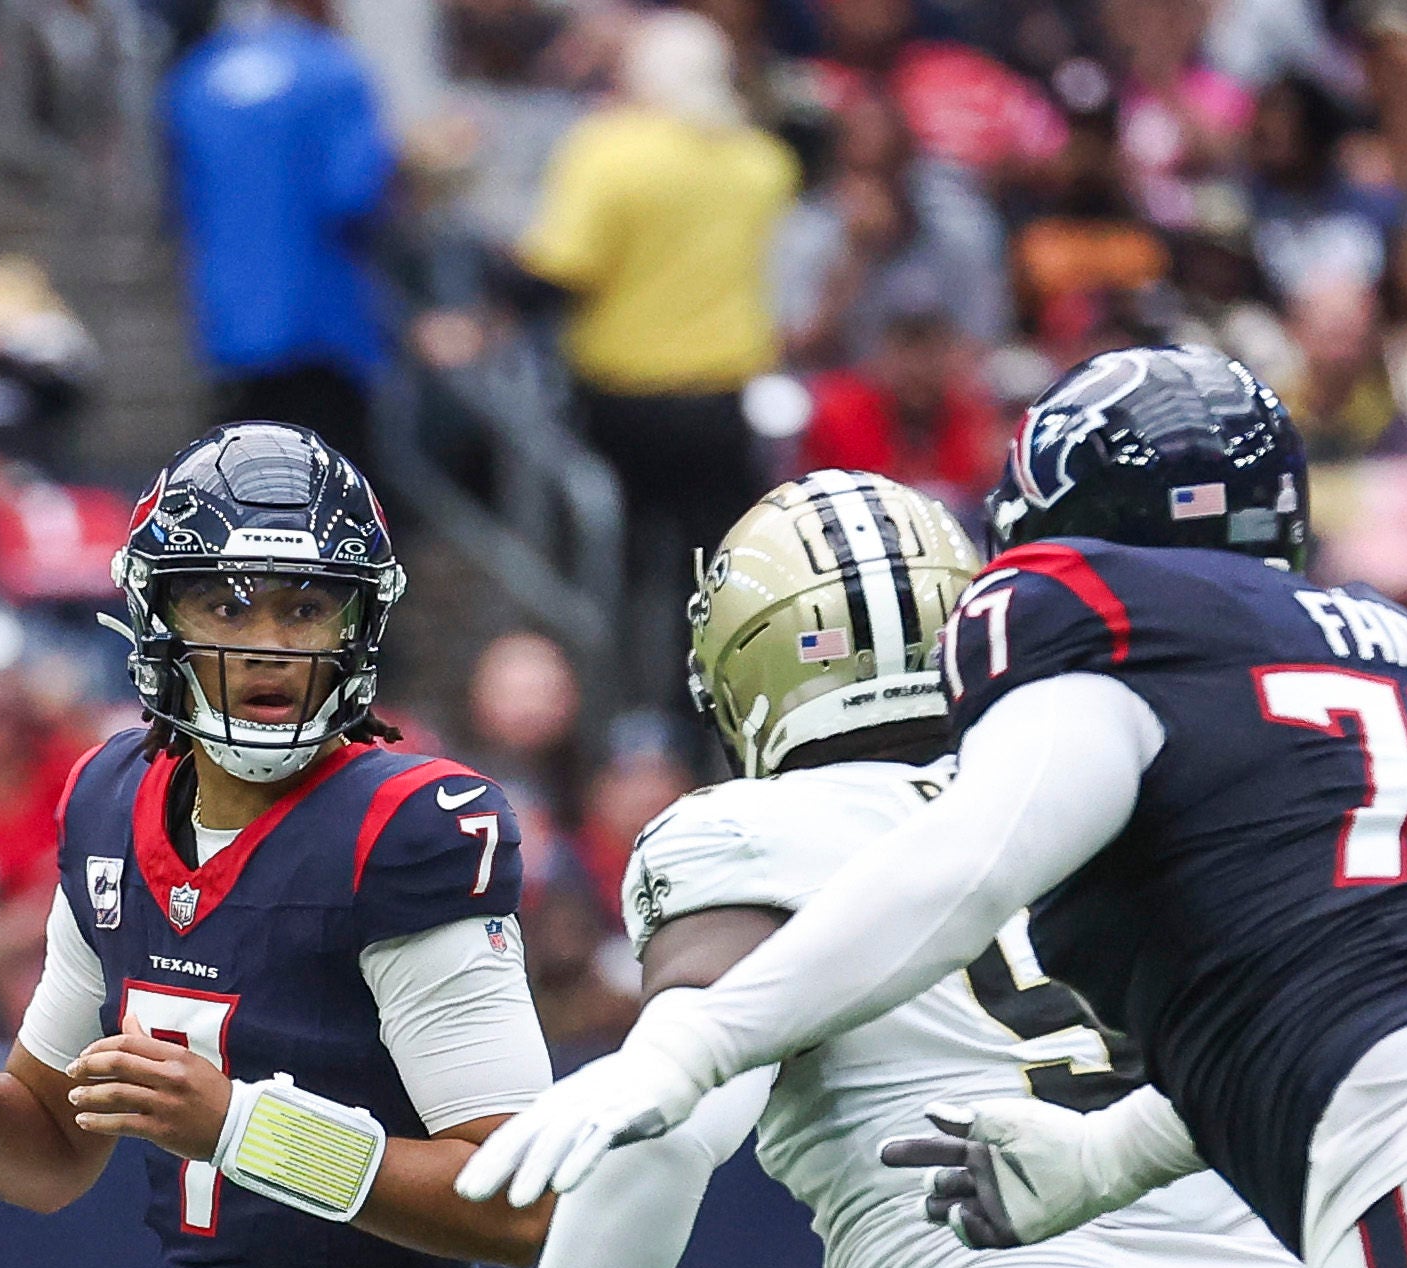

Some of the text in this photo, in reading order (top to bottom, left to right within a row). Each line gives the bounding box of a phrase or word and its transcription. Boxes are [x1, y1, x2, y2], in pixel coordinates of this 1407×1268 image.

[163, 544, 200, 552] OAKLEY
[242, 533, 304, 544] TEXANS
[456, 811, 500, 897] 7
[172, 901, 194, 921] NFL
[148, 954, 219, 980] TEXANS
[120, 977, 241, 1238] 7
